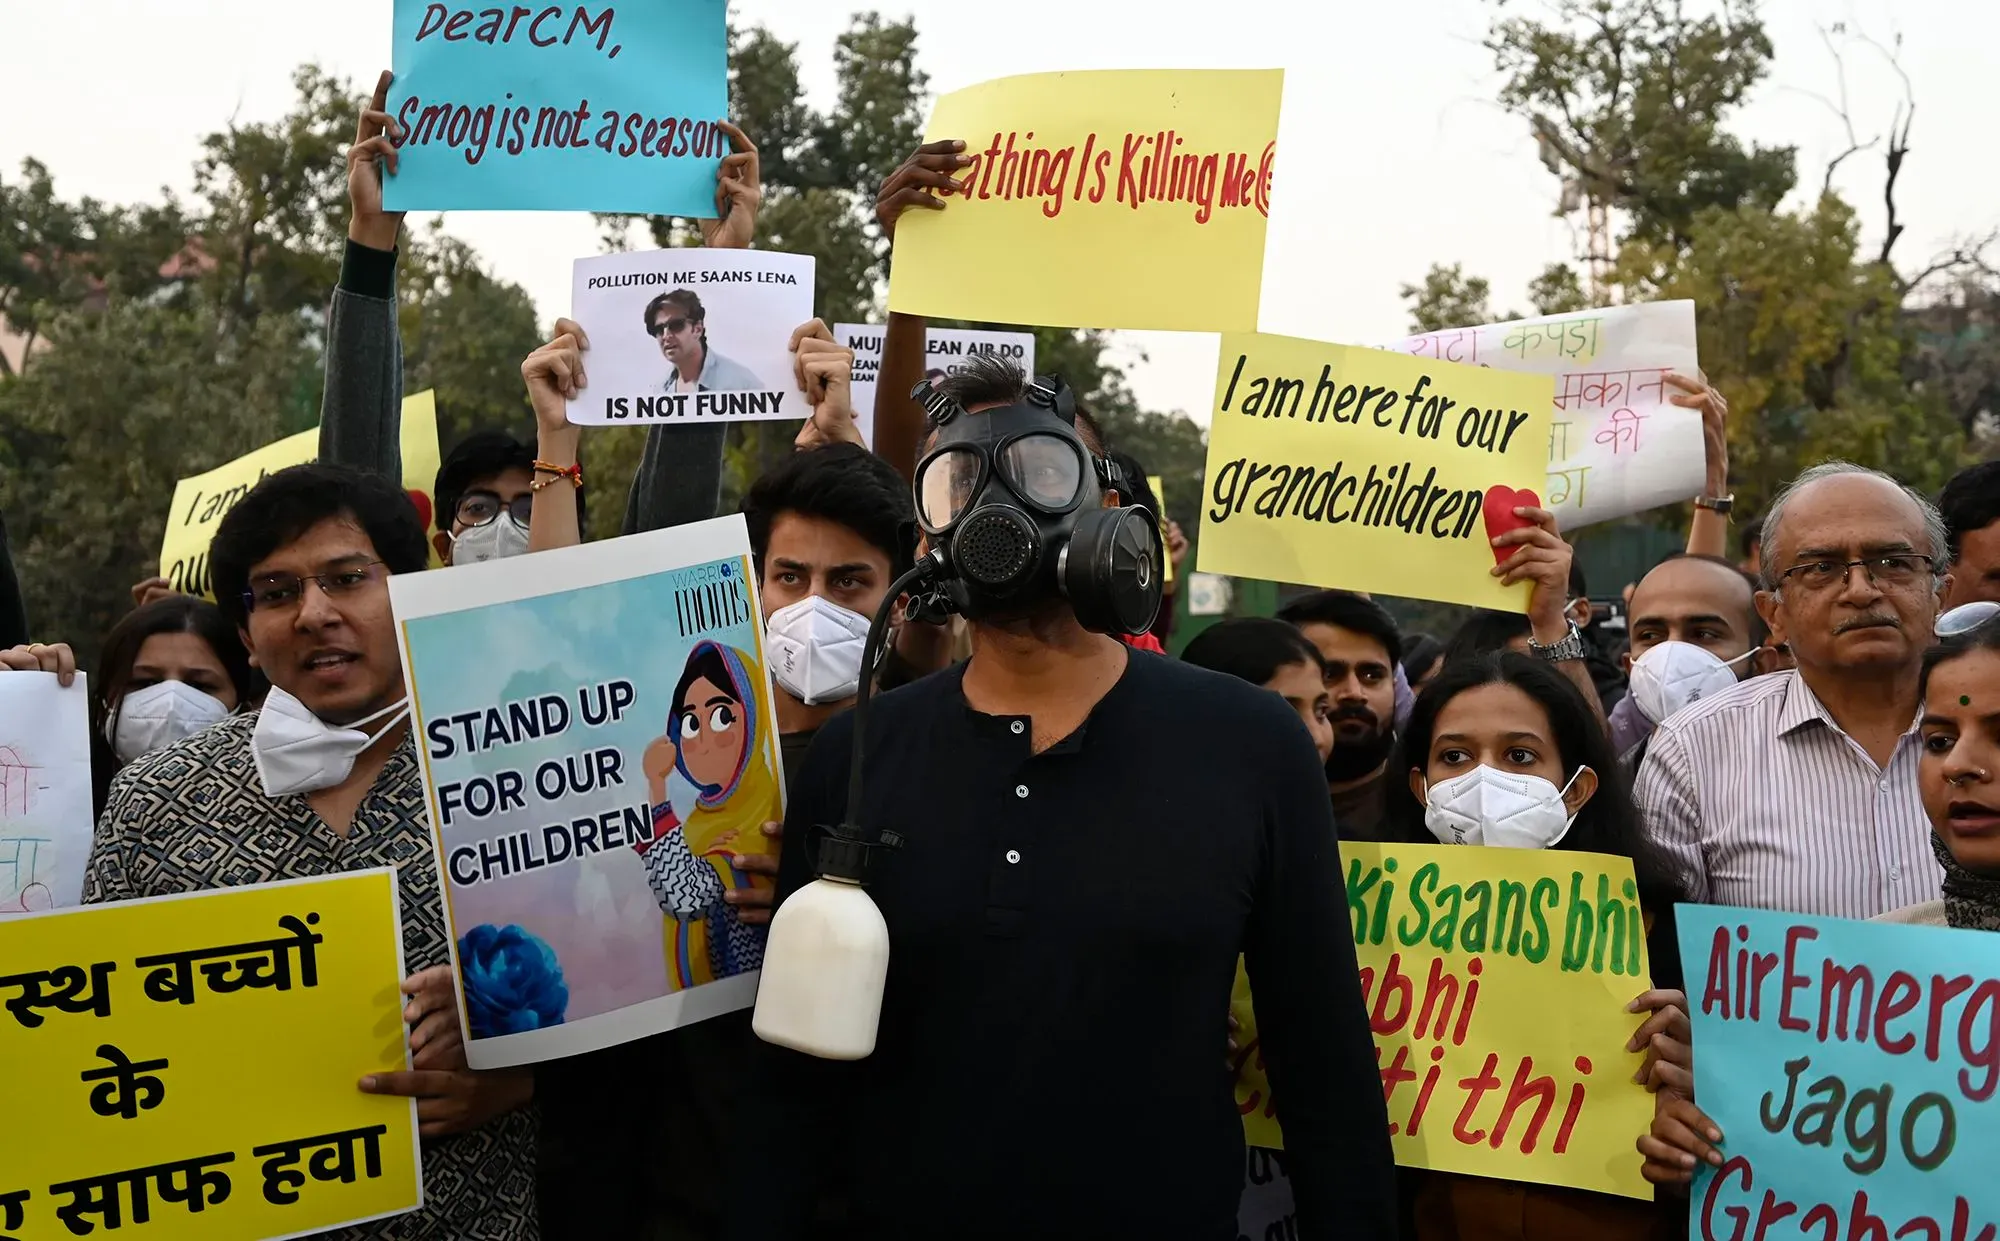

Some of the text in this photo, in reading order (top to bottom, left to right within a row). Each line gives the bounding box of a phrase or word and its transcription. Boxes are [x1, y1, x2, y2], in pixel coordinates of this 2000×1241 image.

[415, 3, 621, 58] Dear CM,
[394, 92, 723, 164] Smog is not a season
[1070, 132, 1111, 204] Is
[1116, 130, 1219, 224] Killing
[1219, 152, 1256, 208] Me
[588, 270, 797, 289] POLLUTION ME SAANS LENA
[849, 335, 886, 354] MUJ
[967, 342, 994, 357] AIR
[1000, 344, 1024, 358] DO
[1504, 317, 1604, 360] कपड़ा
[606, 391, 785, 419] IS NOT FUNNY
[1221, 355, 1247, 412] I
[1241, 374, 1303, 424] am
[1306, 364, 1399, 428] here
[1399, 375, 1457, 441] for
[1456, 406, 1529, 454] our
[1553, 368, 1674, 410] मकान
[1595, 408, 1650, 454] की
[184, 491, 202, 526] I
[1209, 458, 1483, 539] grandchildren
[427, 680, 635, 760] STAND UP
[438, 748, 624, 825] FOR OUR
[448, 802, 654, 886] CHILDREN
[1398, 862, 1560, 965] Saans
[1560, 871, 1642, 977] bhi
[135, 912, 324, 1006] बच्चों
[1702, 925, 1779, 1022] Air
[81, 1043, 170, 1120] के
[1452, 1053, 1592, 1156] thi
[1760, 1055, 1956, 1176] Jago
[49, 1151, 236, 1232] साफ
[252, 1124, 388, 1205] हवा
